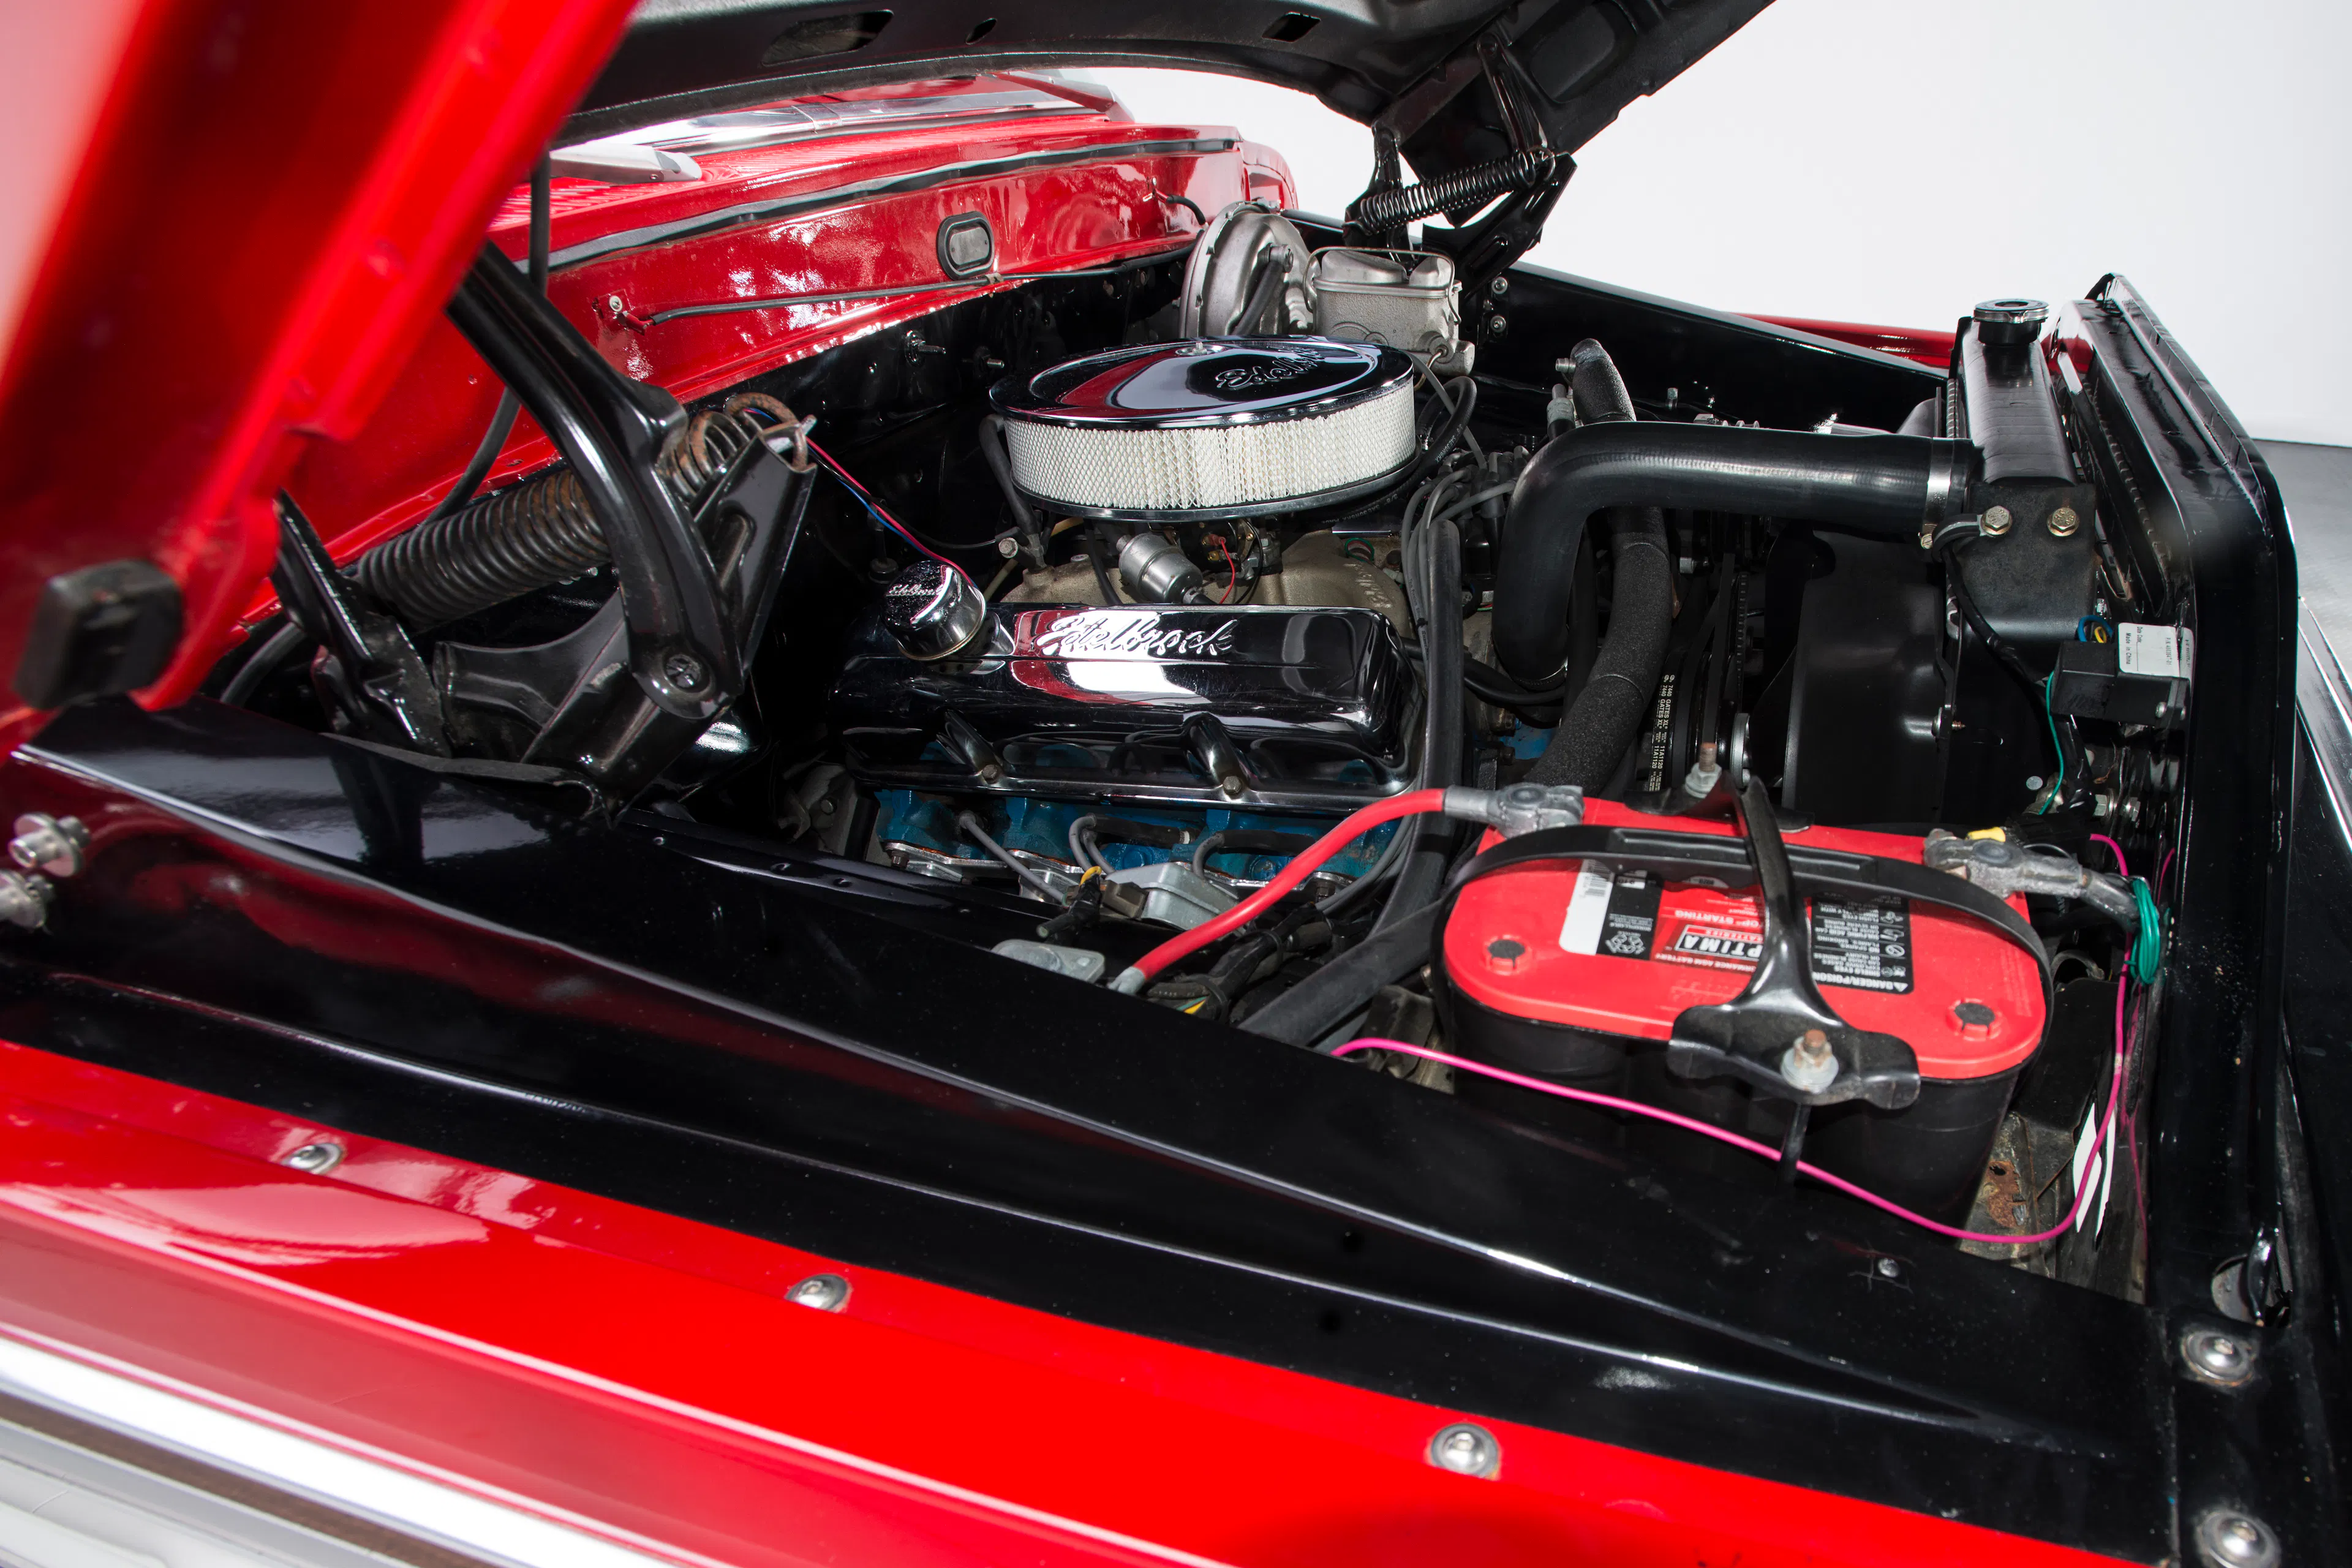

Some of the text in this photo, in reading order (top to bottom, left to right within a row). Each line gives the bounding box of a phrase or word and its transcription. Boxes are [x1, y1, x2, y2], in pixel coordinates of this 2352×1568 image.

[1036, 613, 1238, 656] Edelbrock
[1675, 910, 1734, 925] STARTING
[1683, 934, 1763, 957] PTIMA
[1811, 972, 1894, 990] DANGER/POISON
